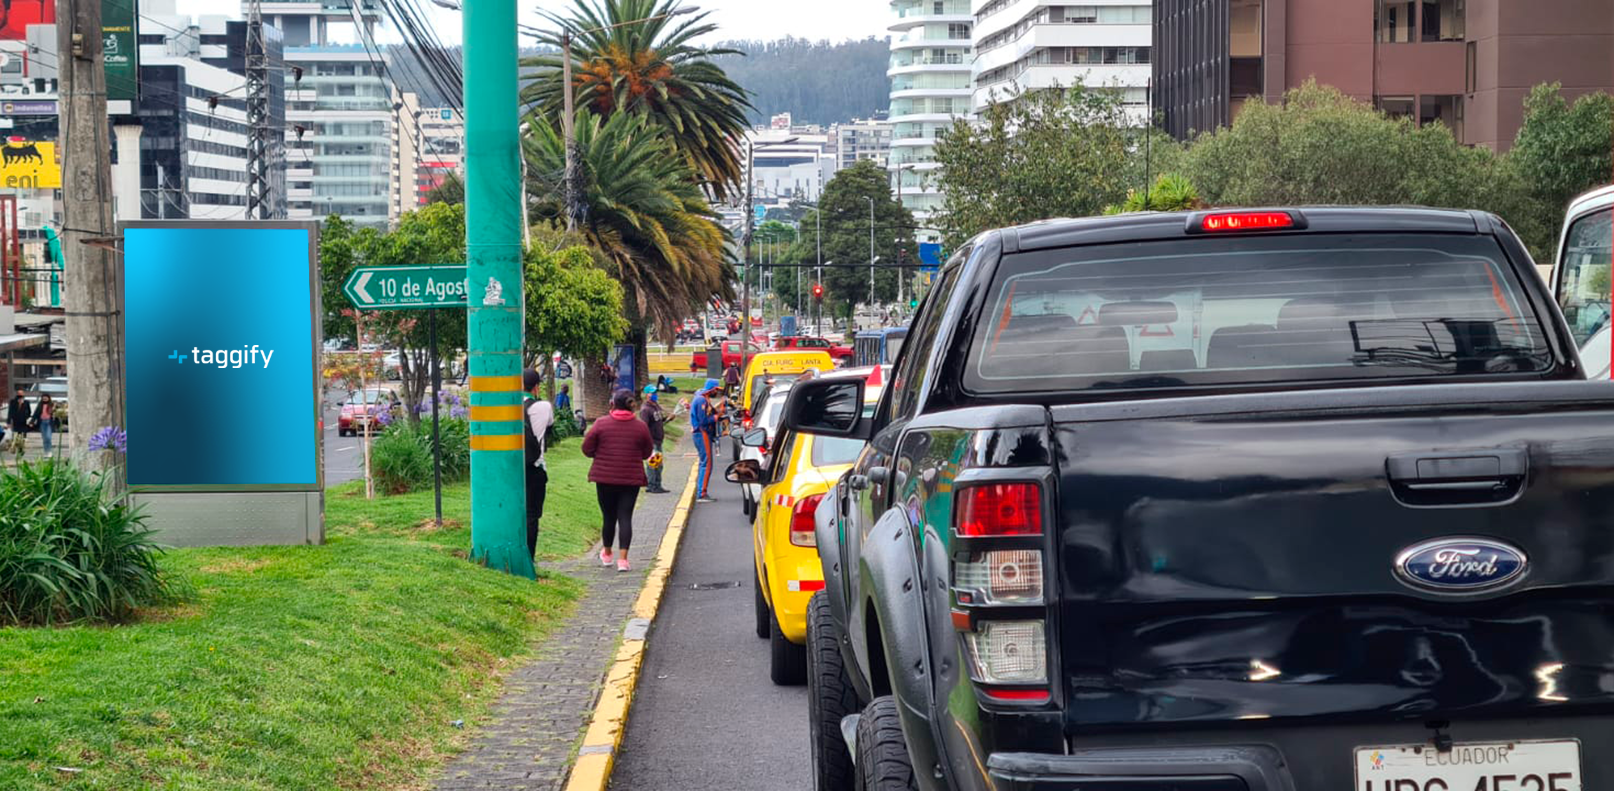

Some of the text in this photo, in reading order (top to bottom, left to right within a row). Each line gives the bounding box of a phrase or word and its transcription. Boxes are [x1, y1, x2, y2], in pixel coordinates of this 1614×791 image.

[6, 169, 38, 189] eni
[379, 278, 397, 297] 10
[401, 276, 420, 297] de
[191, 344, 275, 369] taggify
[1428, 548, 1498, 578] Ford
[1424, 747, 1510, 766] ECUADOR
